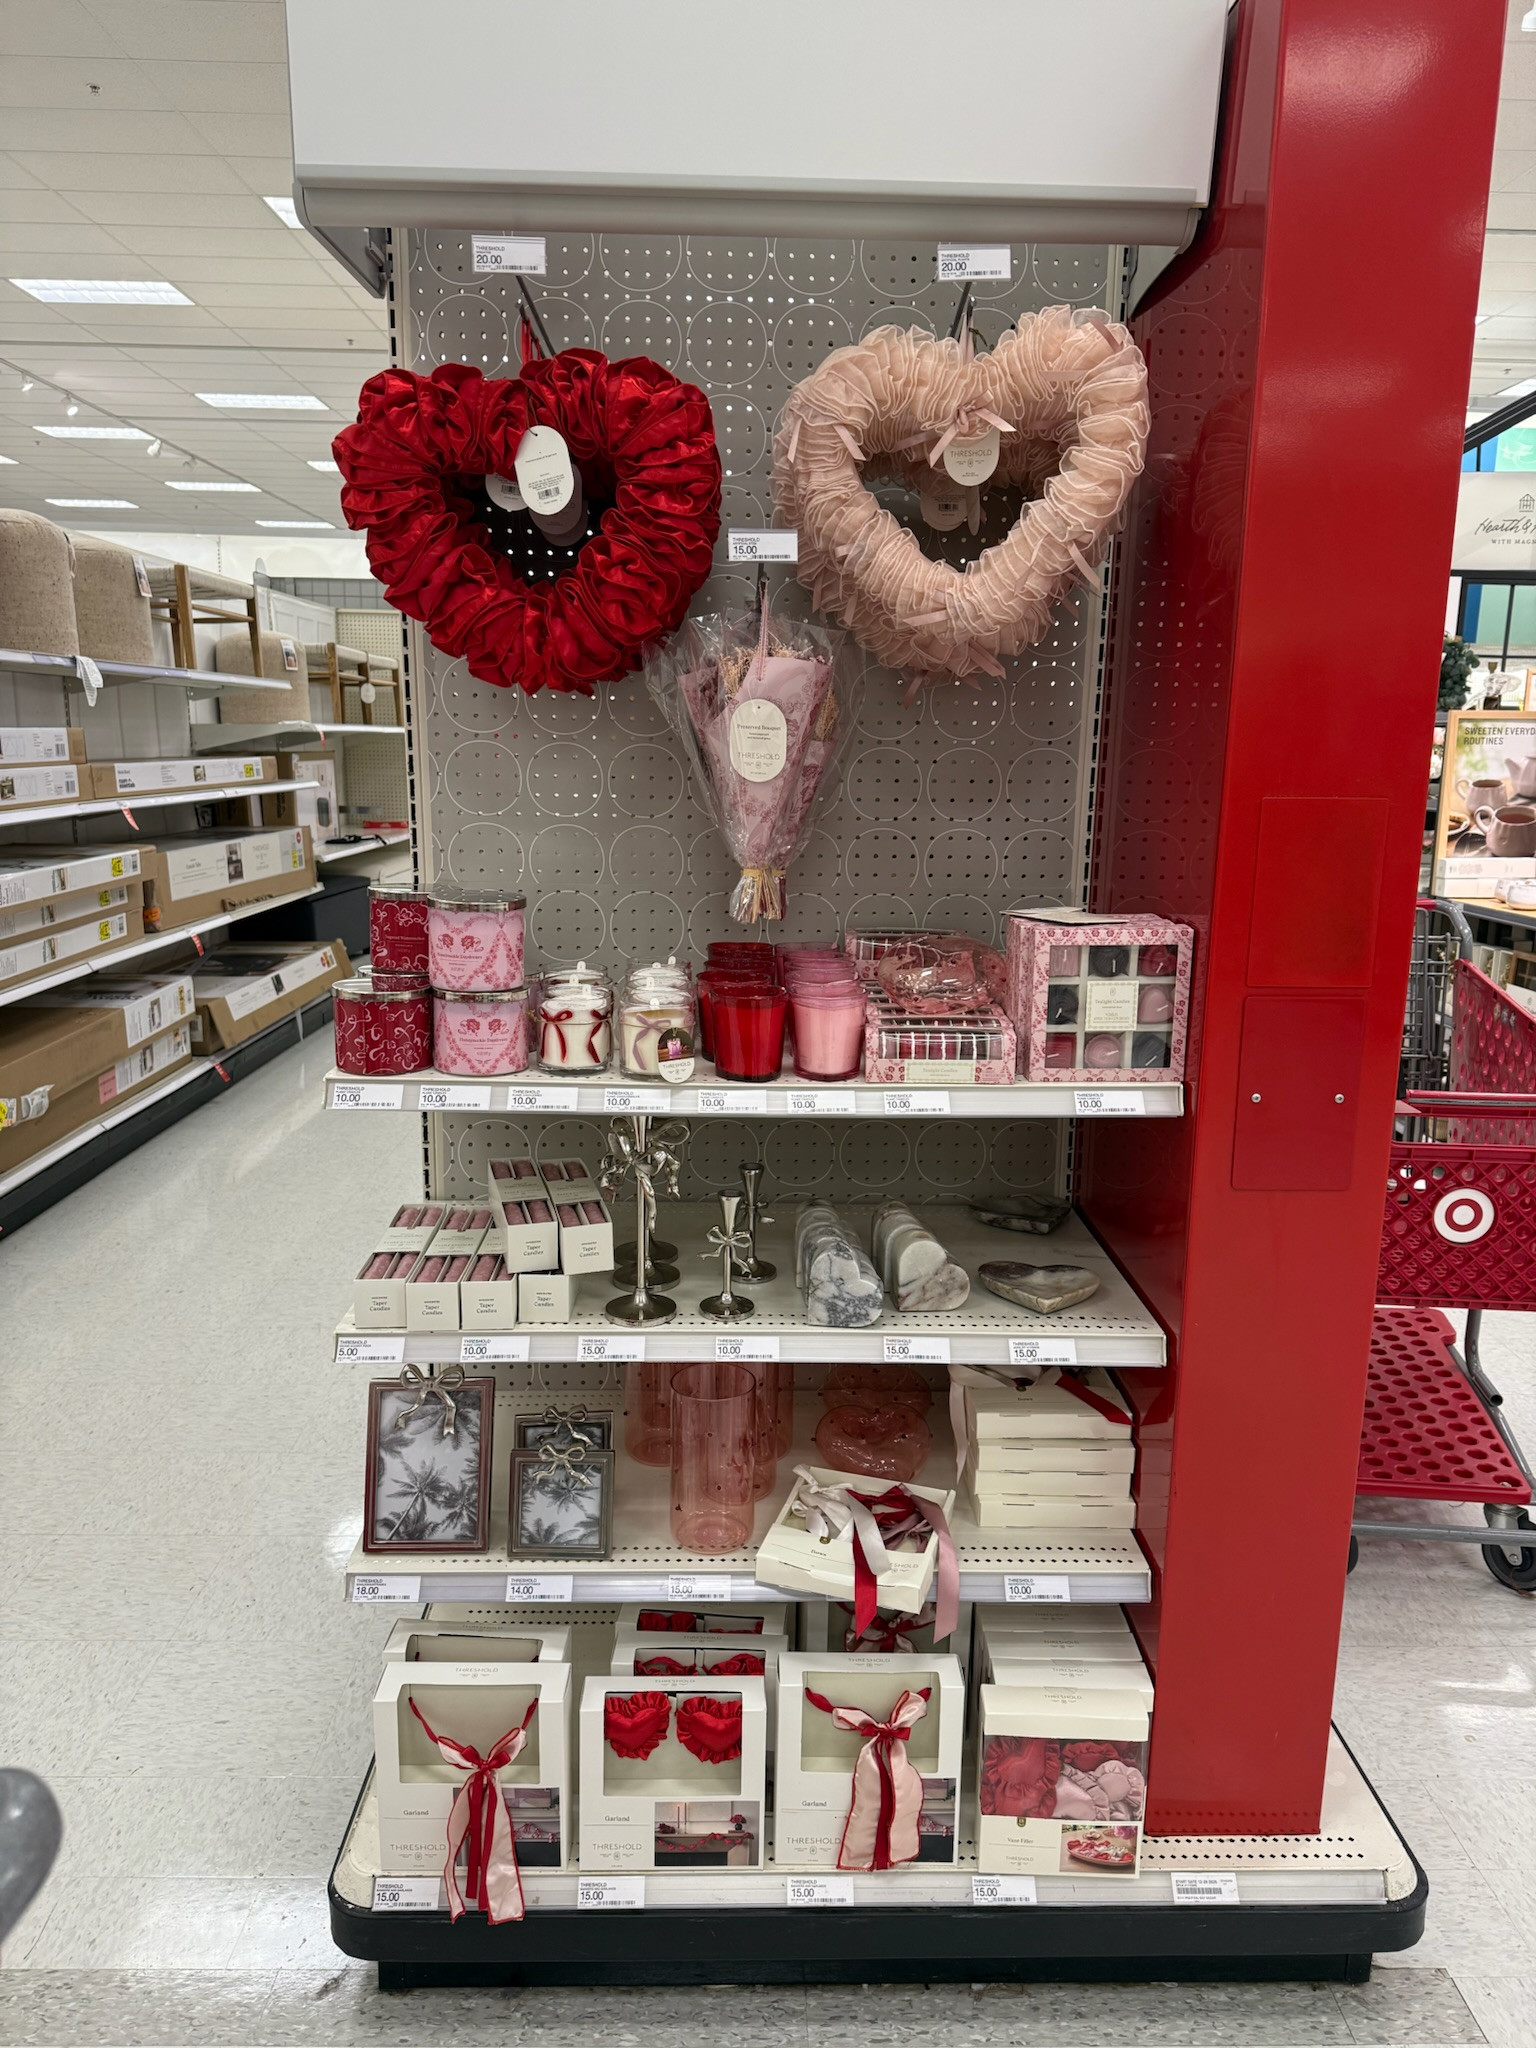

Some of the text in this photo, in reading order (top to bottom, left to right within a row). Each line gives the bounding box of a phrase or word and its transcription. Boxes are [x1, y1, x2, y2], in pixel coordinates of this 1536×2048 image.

[476, 254, 502, 264] 20.00
[941, 262, 967, 272] 20.00
[950, 449, 992, 458] THRESHOLD
[1474, 516, 1532, 535] Hearth &
[734, 546, 757, 554] 15.00
[1464, 727, 1503, 735] SWEETEN
[1463, 737, 1504, 745] ROUTINES
[737, 752, 780, 760] THRESHOLD
[663, 1061, 691, 1069] THRESHOLD
[336, 1094, 361, 1102] 10.00
[422, 1095, 447, 1103] 10.00
[512, 1097, 537, 1105] 10.00
[607, 1098, 631, 1106] 10.00
[701, 1099, 725, 1107] 10.00
[793, 1100, 816, 1109] 10.00
[887, 1100, 911, 1109] 10.00
[1078, 1100, 1102, 1109] 10.00
[338, 1348, 358, 1356] 5.00
[465, 1346, 489, 1355] 10.00
[583, 1346, 606, 1355] 15.00
[718, 1346, 741, 1355] 10.00
[887, 1346, 910, 1355] 15.00
[1015, 1349, 1038, 1358] 15.00
[811, 1549, 827, 1557] Bows
[357, 1587, 380, 1595] 18.00
[511, 1586, 534, 1595] 14.00
[671, 1585, 694, 1594] 15.00
[1010, 1586, 1032, 1595] 10.00
[786, 1837, 841, 1845] THRESHOLD
[376, 1892, 400, 1901] 15.00
[580, 1891, 604, 1901] 15.00
[792, 1888, 815, 1898] 15.00
[975, 1888, 998, 1897] 15.00
